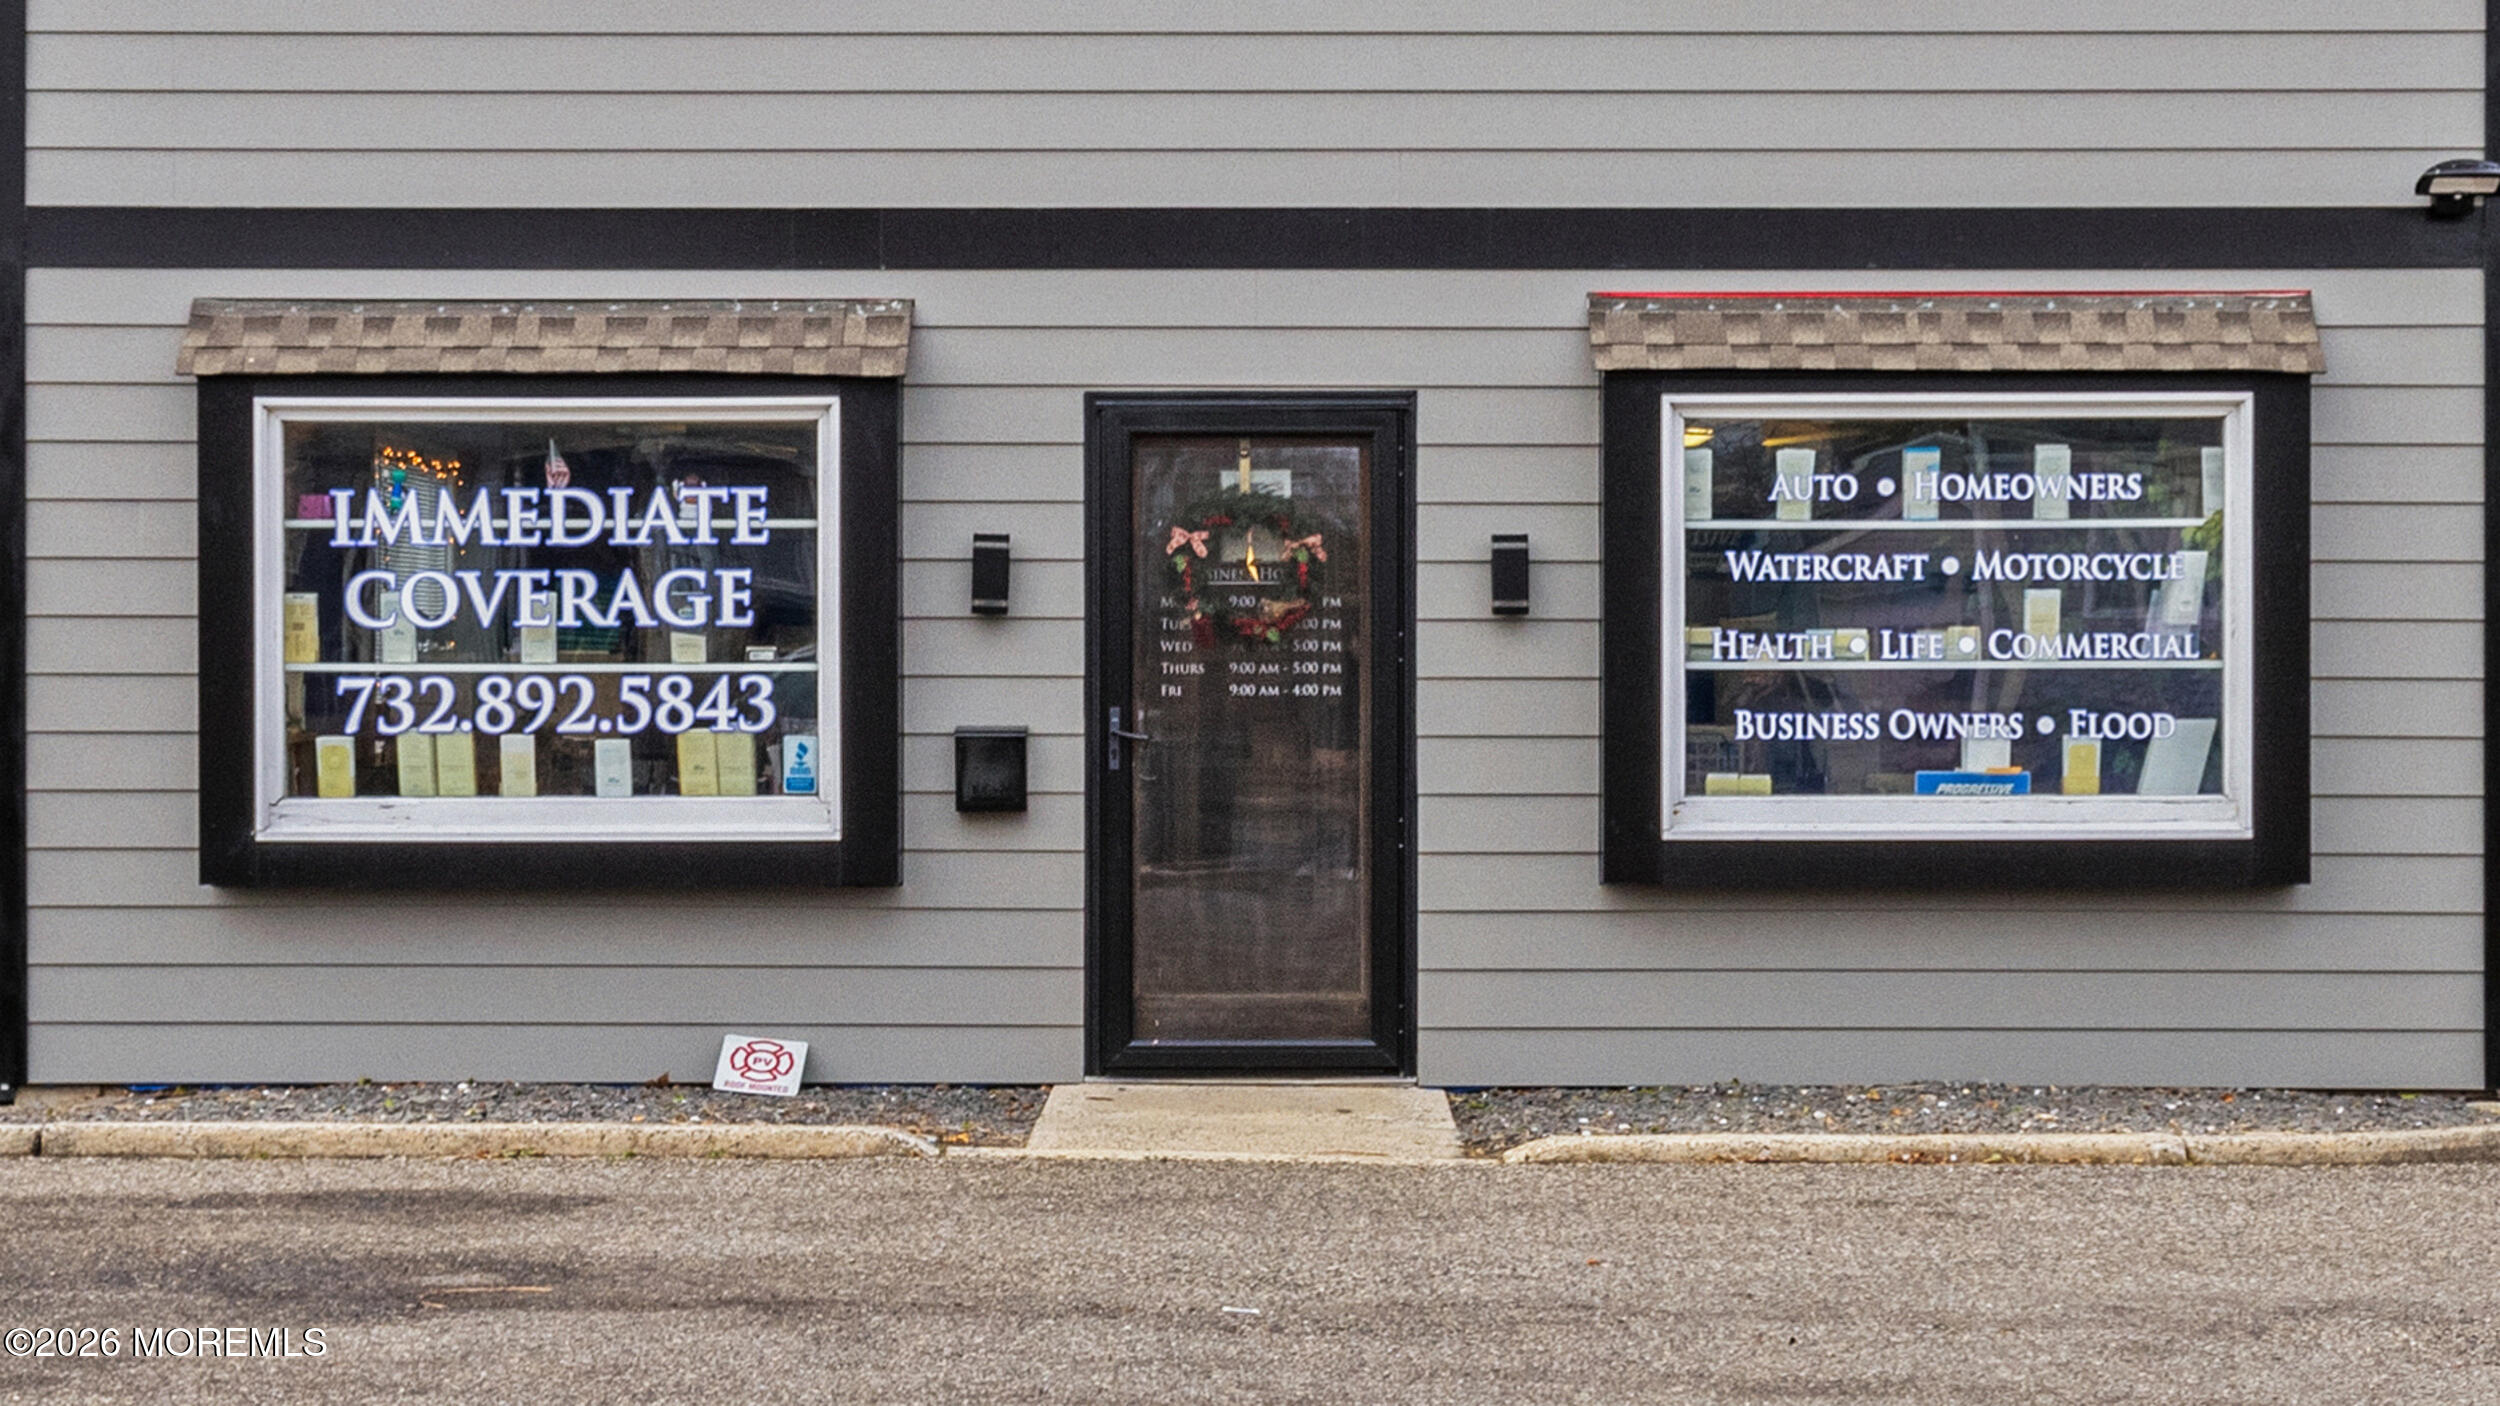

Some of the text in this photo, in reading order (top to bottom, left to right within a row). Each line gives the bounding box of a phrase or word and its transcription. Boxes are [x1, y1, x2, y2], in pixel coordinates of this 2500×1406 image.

[1768, 472, 2142, 502] AUTO HOMEOWNERS
[329, 485, 770, 548] IMMEDIATE
[1725, 551, 1929, 581] WATERCRAFT
[1973, 550, 2186, 582] MOTORCYCLE
[344, 567, 755, 631] COVERAGE
[1322, 597, 1342, 607] PM
[1322, 618, 1342, 629] PM
[1161, 641, 1192, 653] WED
[1322, 641, 1342, 652] PM
[1711, 629, 2200, 660] HEALTH LIFE COMMERCIAL
[1161, 662, 1205, 674] THURS
[1258, 664, 1279, 674] AM
[1322, 663, 1342, 674] PM
[1161, 685, 1182, 697] FRI
[1258, 686, 1280, 696] AM
[1322, 685, 1342, 696] PM
[337, 673, 777, 736] 732.892.5843
[1734, 709, 2176, 740] BUSINESS OWNERS FLOOD
[1936, 783, 2015, 795] PROGRESSIVE
[753, 1056, 773, 1067] PV
